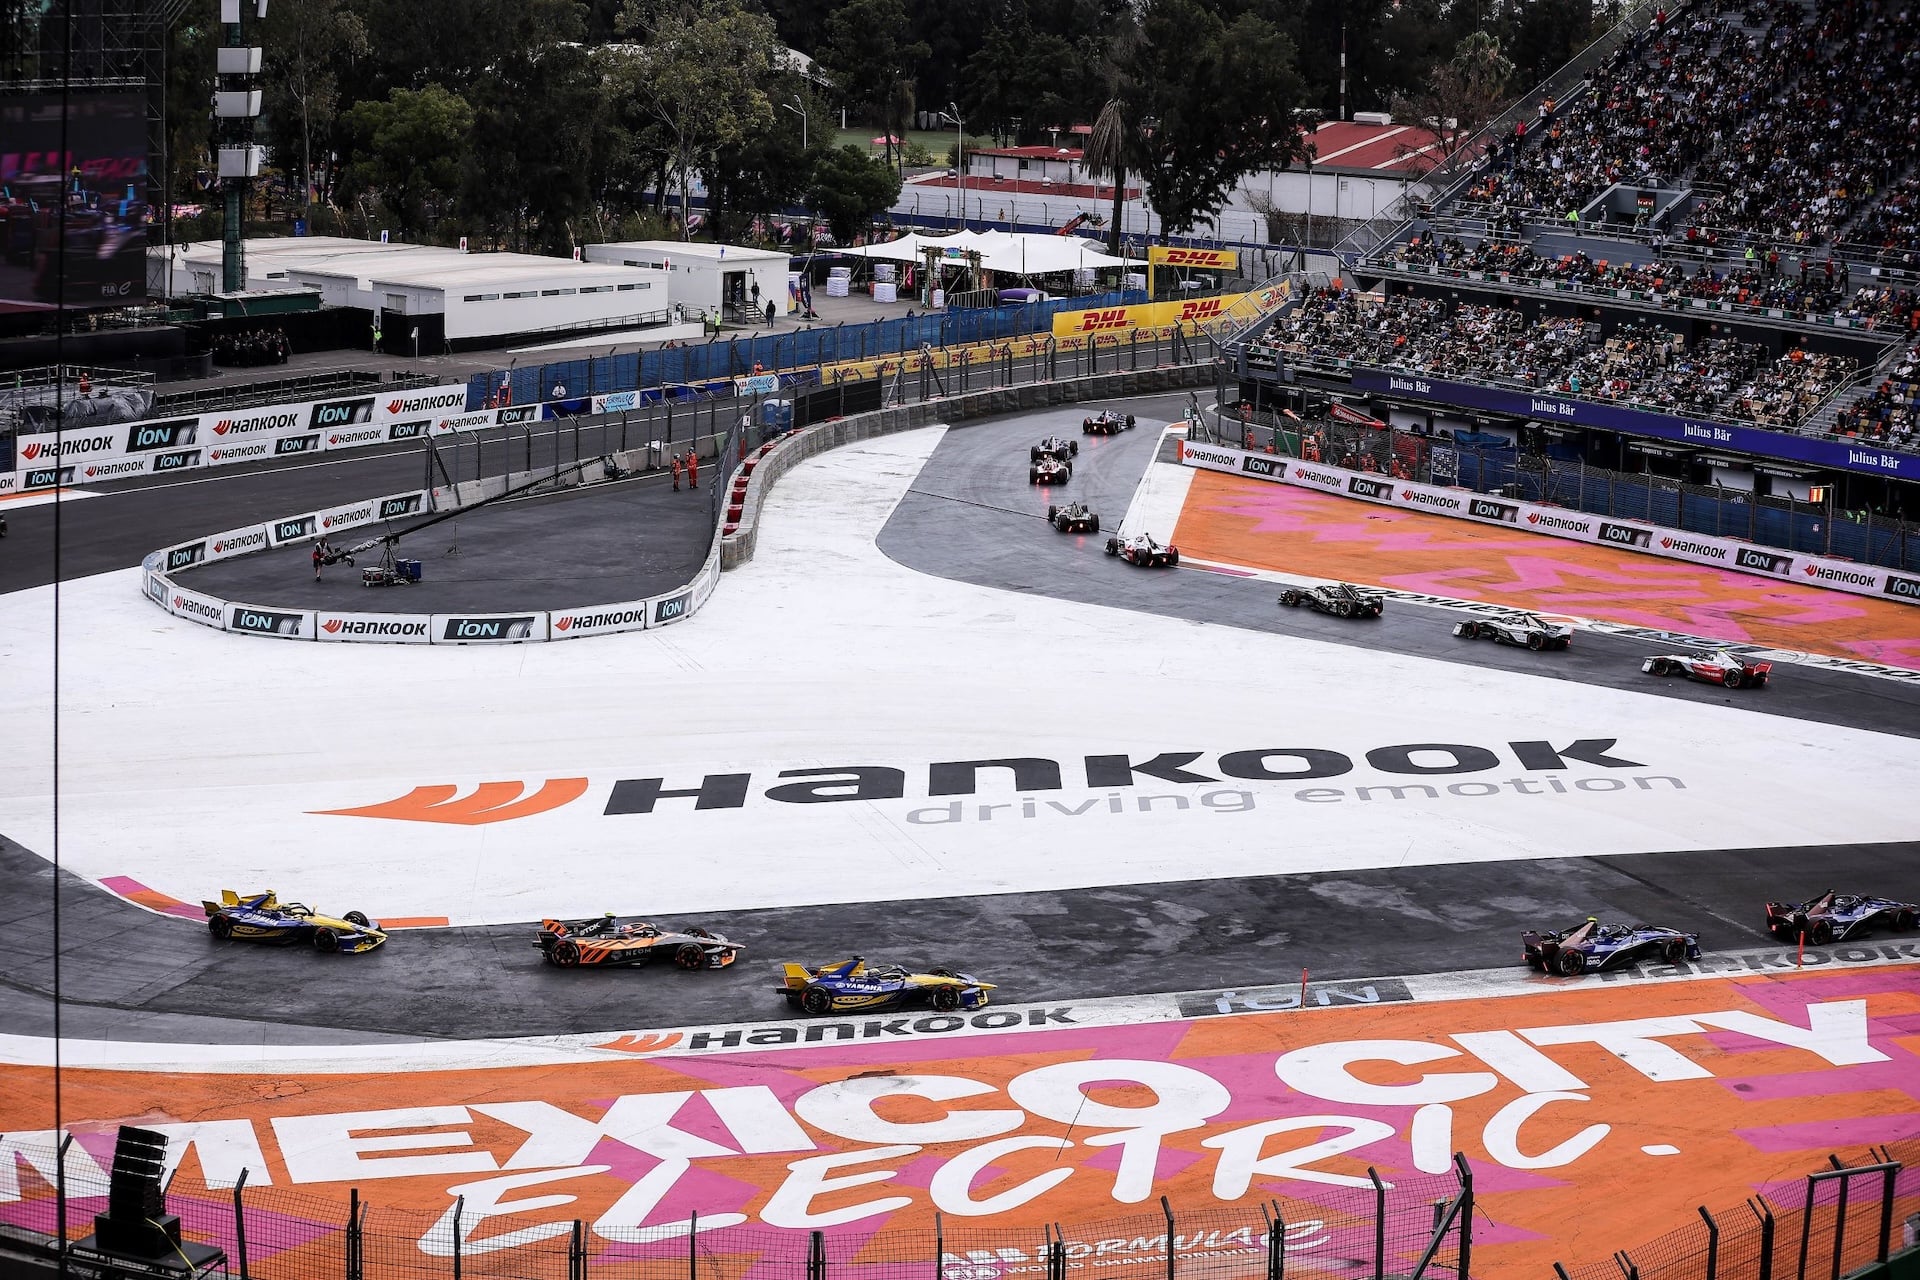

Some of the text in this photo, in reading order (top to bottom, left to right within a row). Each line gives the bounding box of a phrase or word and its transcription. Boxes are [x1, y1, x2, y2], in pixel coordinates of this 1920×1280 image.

[1167, 250, 1224, 266] DHL
[1181, 300, 1223, 320] DHL
[1082, 309, 1127, 331] DHL
[1390, 377, 1431, 394] Julius Bär
[1531, 399, 1575, 416] Julius Bär
[1684, 423, 1731, 441] Julius Bär
[1849, 450, 1900, 470] Julius Bär
[906, 771, 1687, 826] driving emotion
[585, 923, 600, 934] TDK
[625, 948, 651, 957] NEOM
[846, 983, 883, 991] YAMAHA
[0, 999, 1893, 1201] MEXICO CITY
[940, 1247, 1029, 1267] ABB
